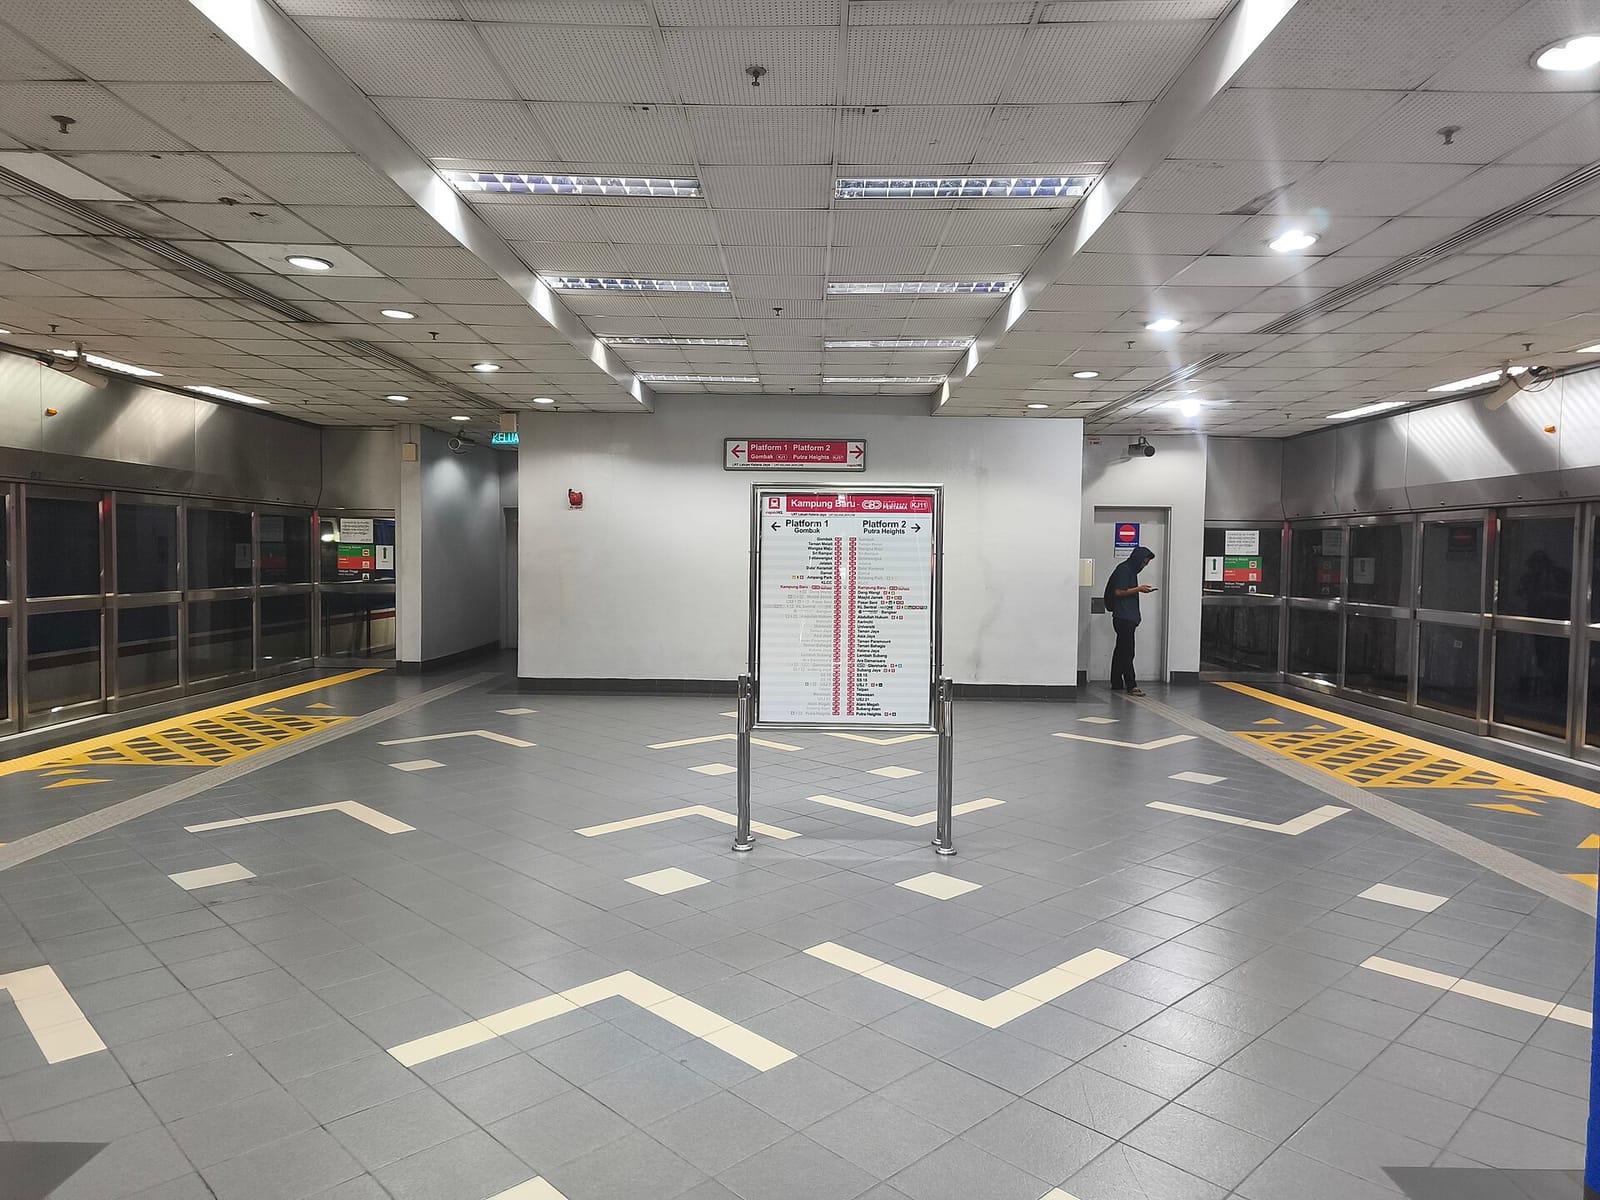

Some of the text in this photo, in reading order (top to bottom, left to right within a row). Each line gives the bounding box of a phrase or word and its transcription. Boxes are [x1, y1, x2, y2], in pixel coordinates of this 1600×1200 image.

[791, 499, 833, 508] Kampung
[835, 499, 855, 508] Baru
[786, 519, 822, 527] Platform
[862, 520, 907, 528] Platform 2
[881, 528, 905, 536] Heights
